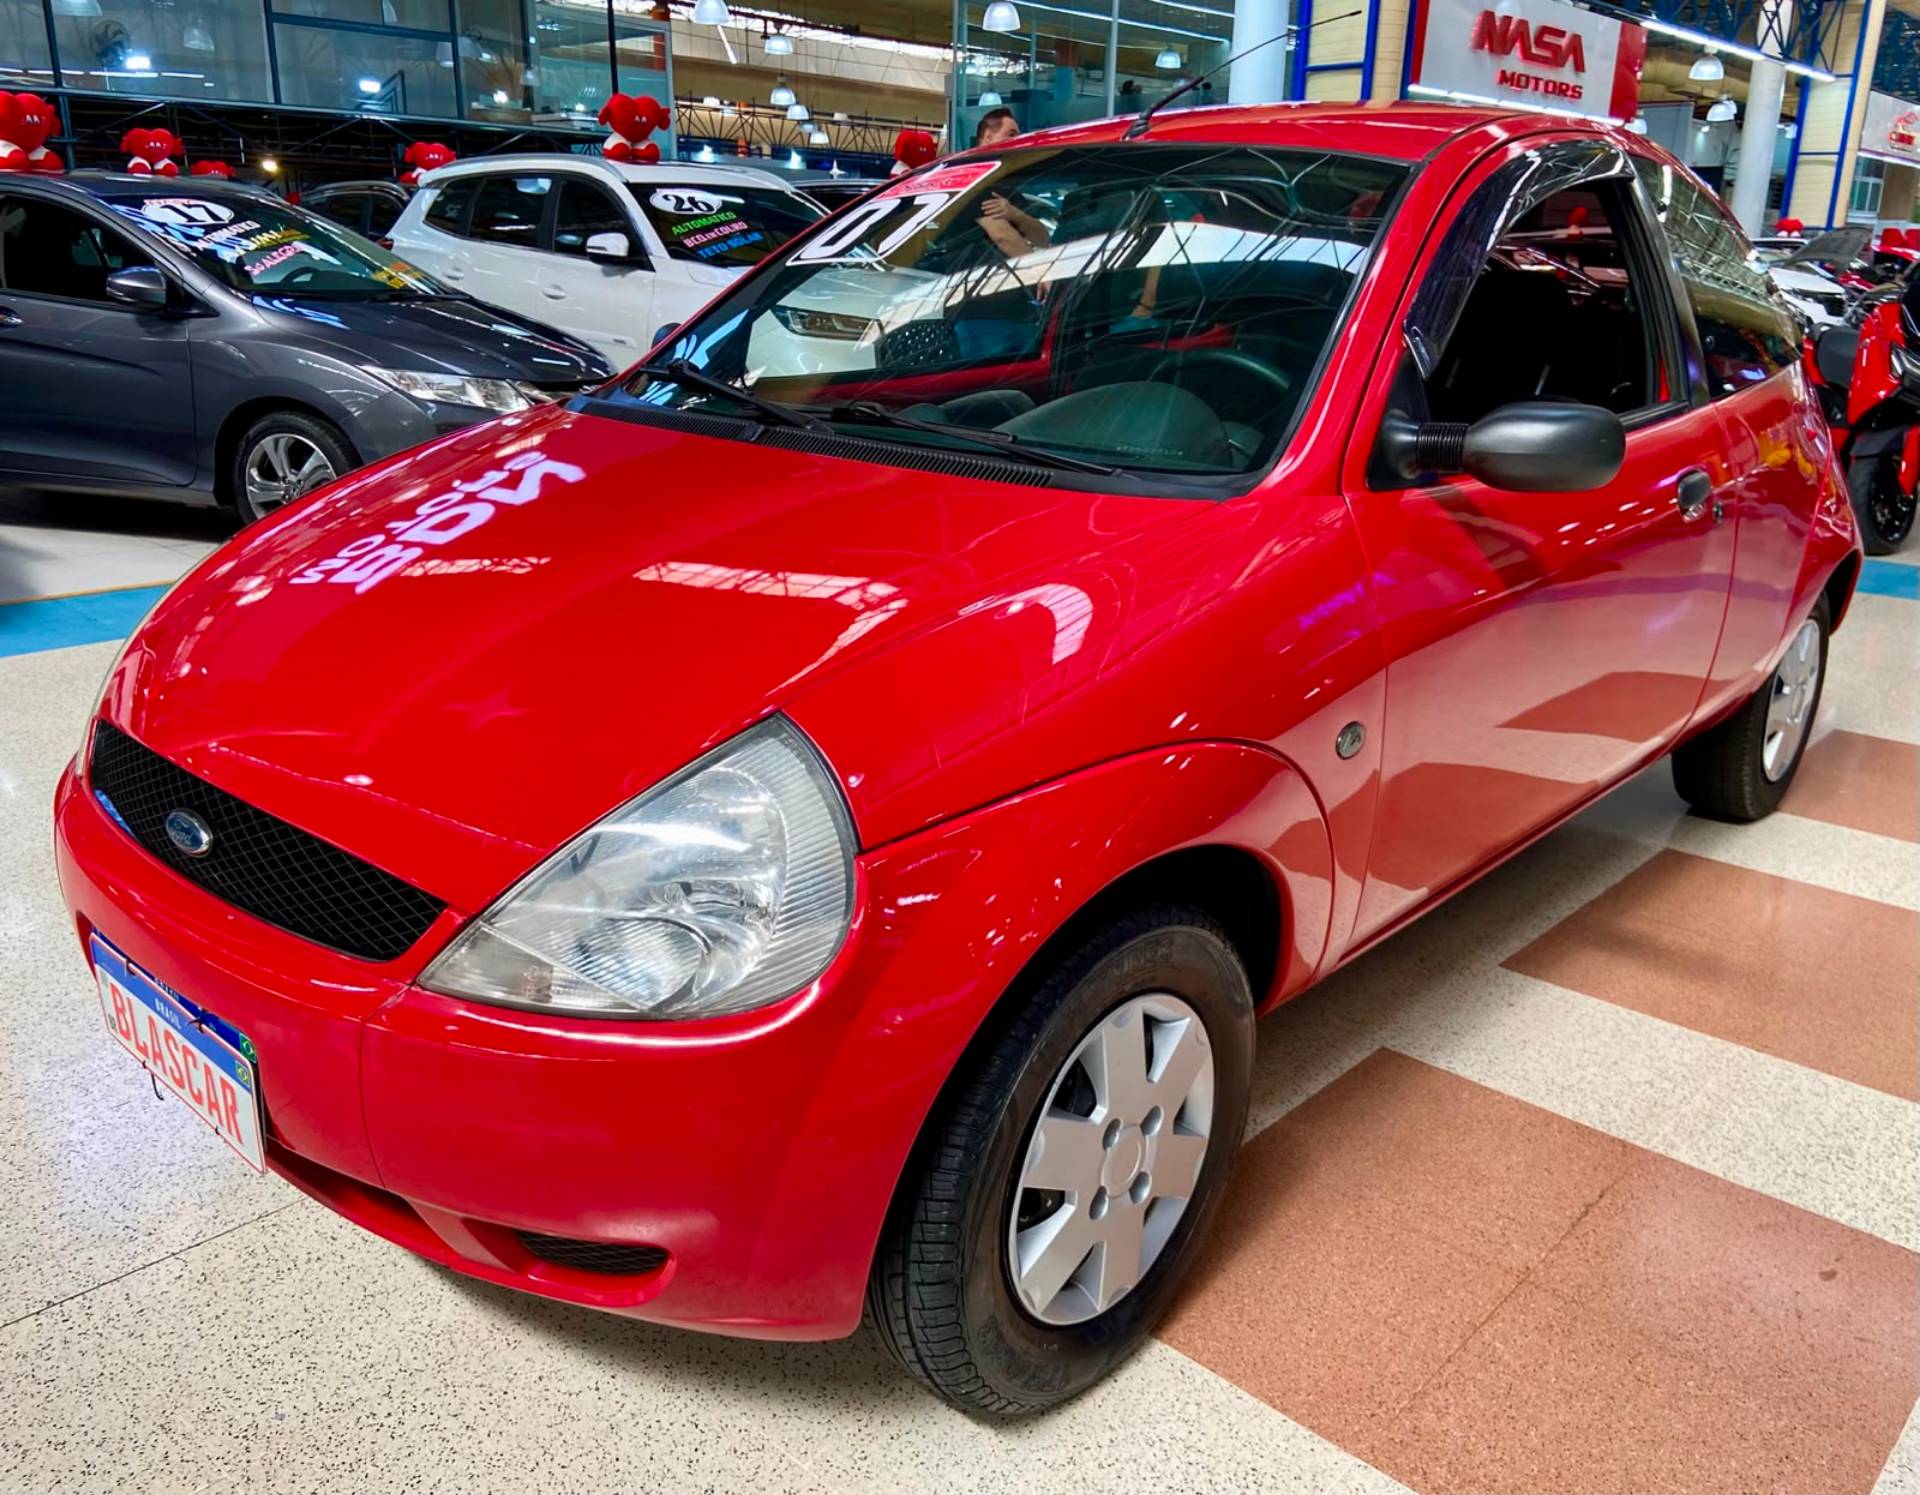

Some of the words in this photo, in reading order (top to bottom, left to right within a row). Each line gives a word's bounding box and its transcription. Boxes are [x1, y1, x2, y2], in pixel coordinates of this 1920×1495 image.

[1473, 10, 1586, 73] NASA
[1498, 69, 1584, 100] MOTORS
[160, 203, 227, 224] 17
[662, 193, 715, 213] 26
[671, 211, 737, 235] AUTOMATICO
[697, 242, 729, 259] TETO
[154, 997, 182, 1030] BRASIL
[109, 982, 243, 1145] BLASCAR
